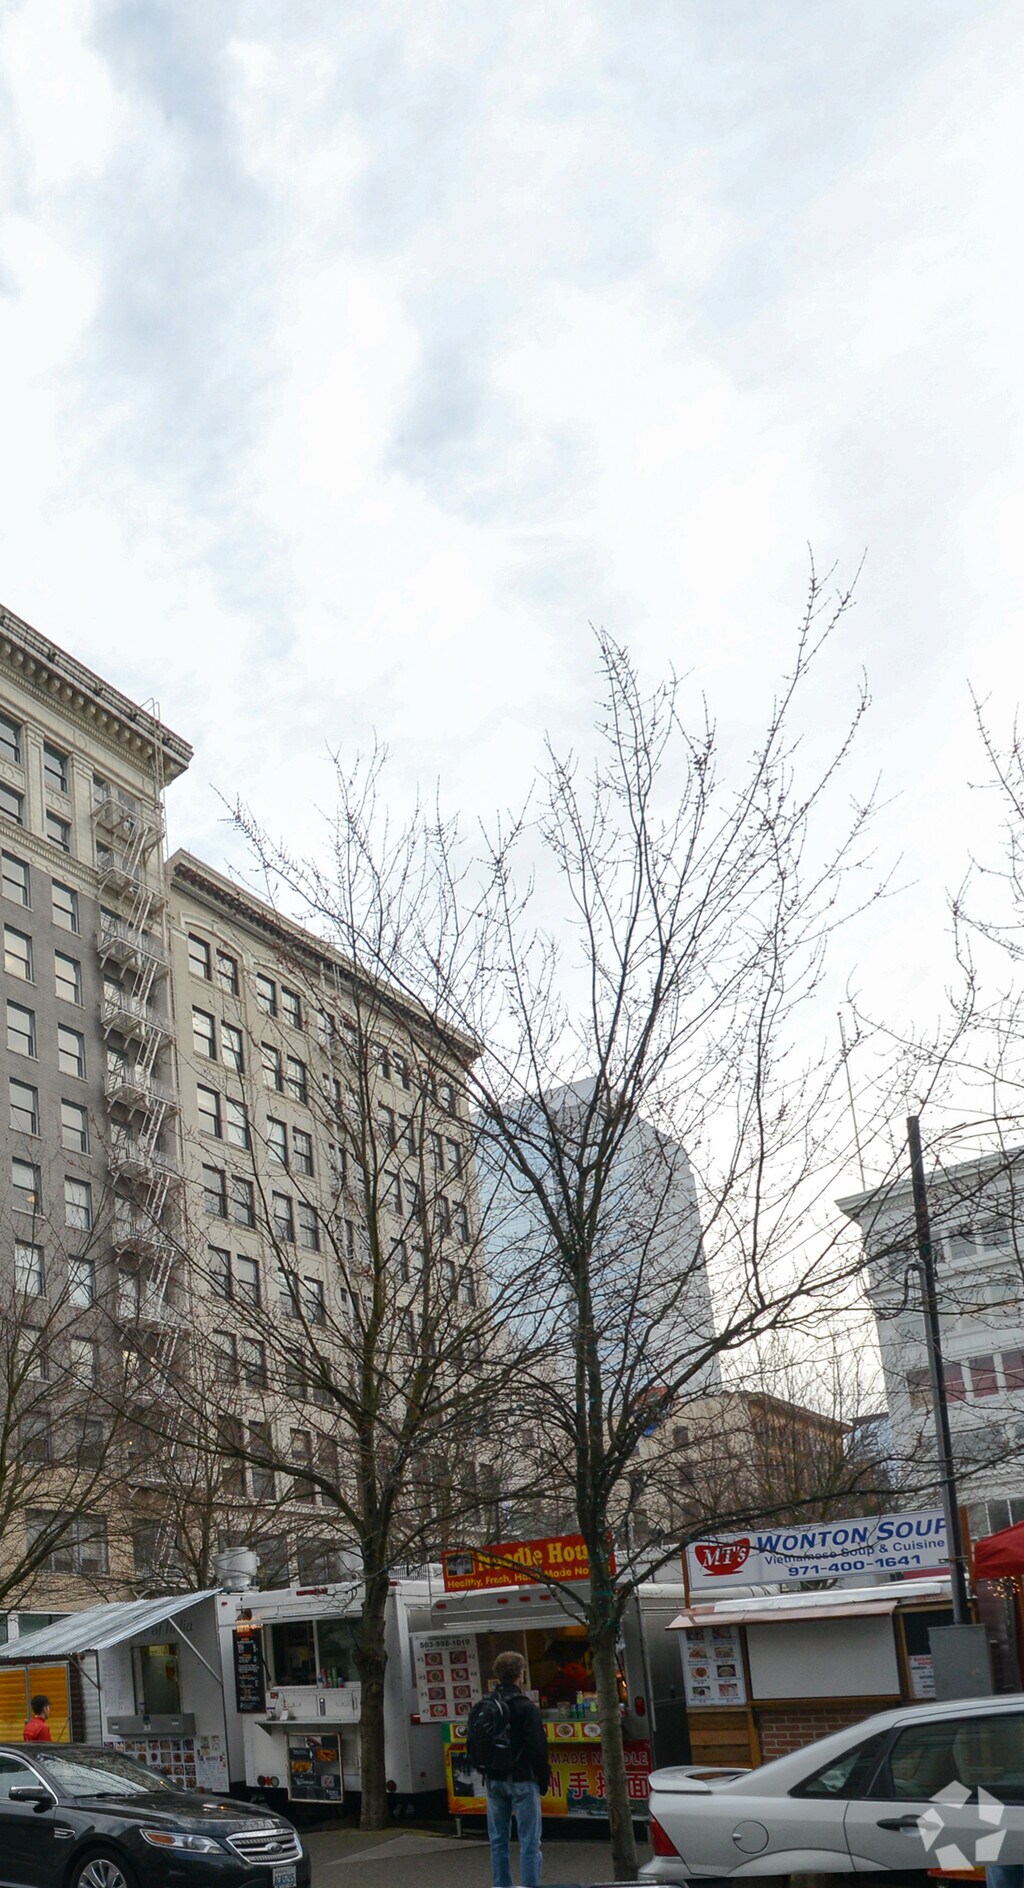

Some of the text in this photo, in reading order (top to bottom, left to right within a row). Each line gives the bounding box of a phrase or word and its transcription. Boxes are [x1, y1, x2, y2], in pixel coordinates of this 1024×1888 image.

[757, 1517, 946, 1553] WONTON SOUP
[547, 1542, 589, 1563] Hou
[764, 1538, 945, 1566] Vietnamese Soup & Cuisine
[545, 1566, 572, 1578] Made
[788, 1554, 921, 1577] 971-400-1641
[551, 1751, 649, 1767] MADE NDLE
